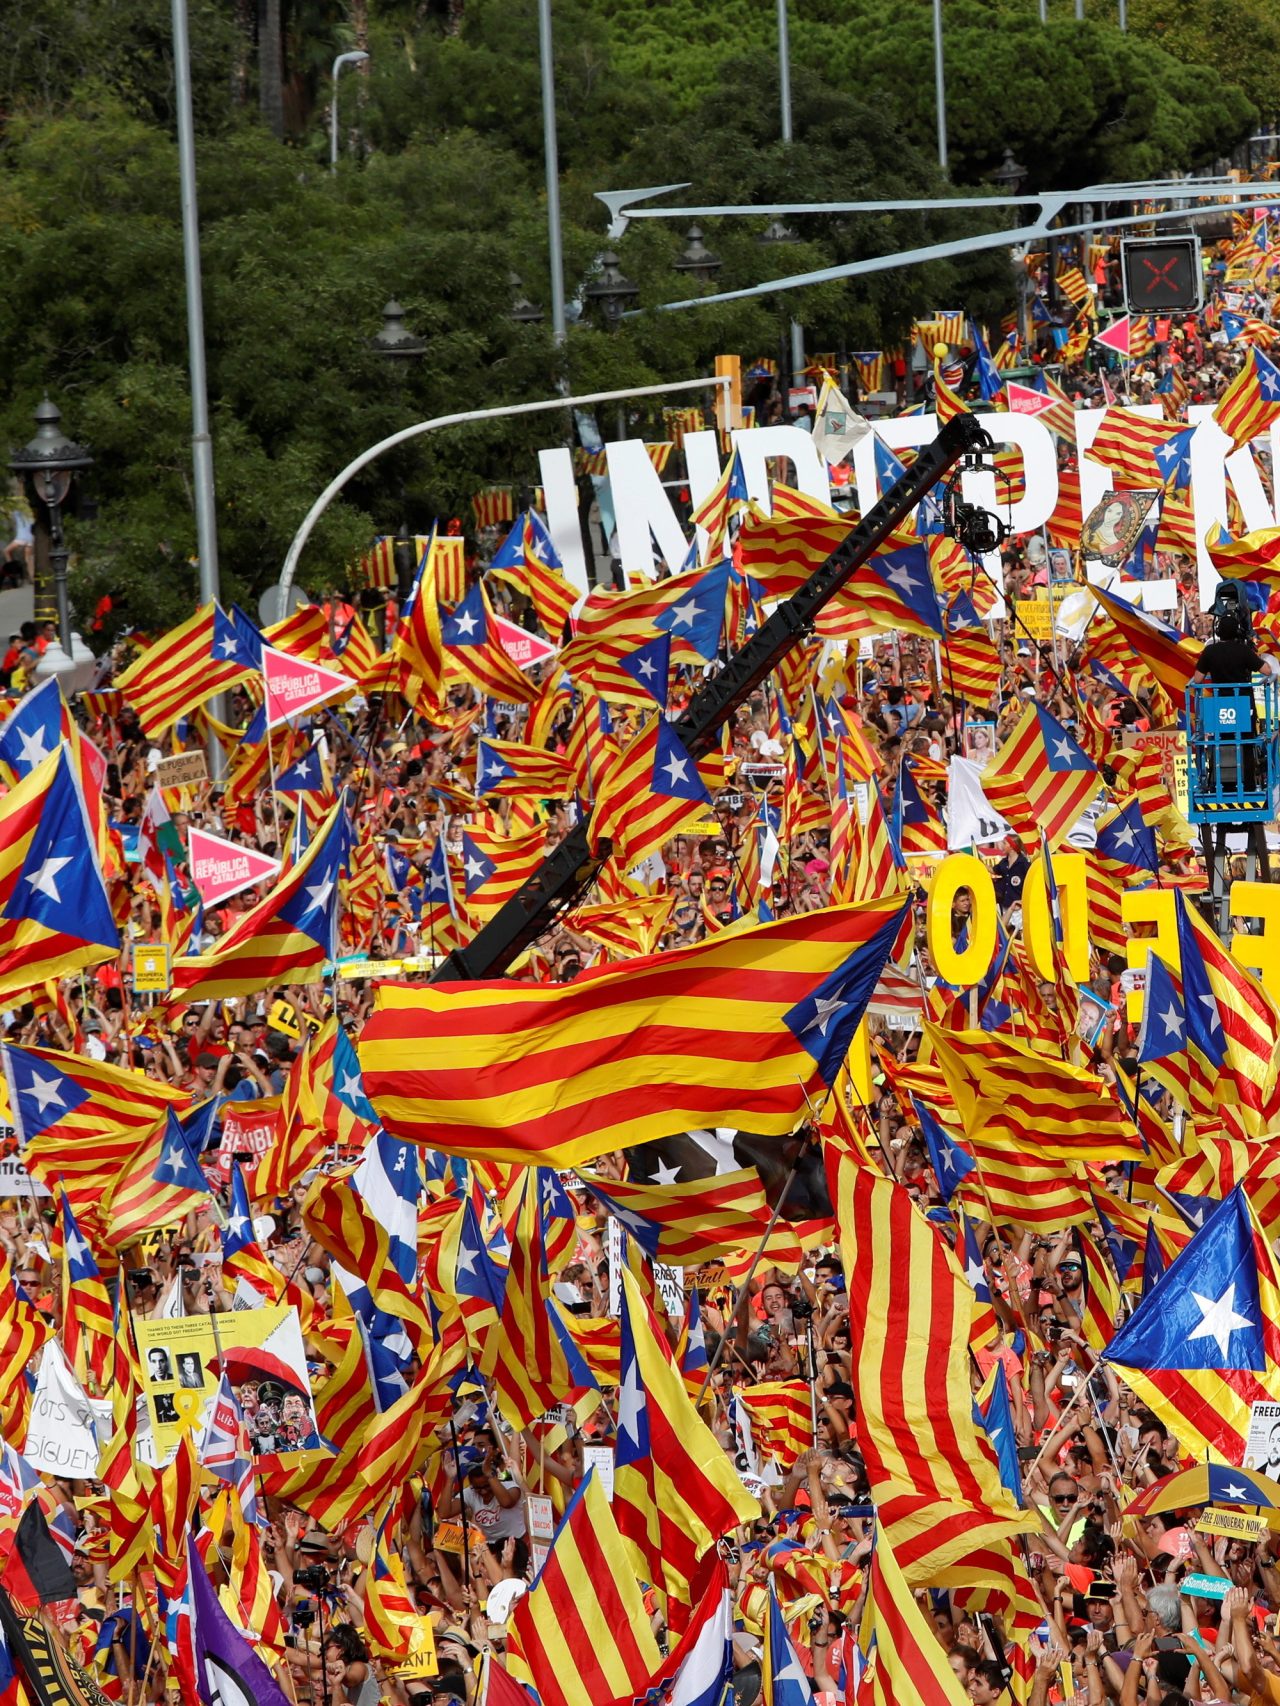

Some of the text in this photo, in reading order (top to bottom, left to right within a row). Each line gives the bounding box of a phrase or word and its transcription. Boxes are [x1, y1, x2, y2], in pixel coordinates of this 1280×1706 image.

[1219, 708, 1236, 719] 50
[196, 856, 249, 880] REPÚBLICA
[211, 869, 251, 885] CATALANA
[1202, 1512, 1213, 1524] FREE
[1213, 1513, 1245, 1529] JUNQUERAS
